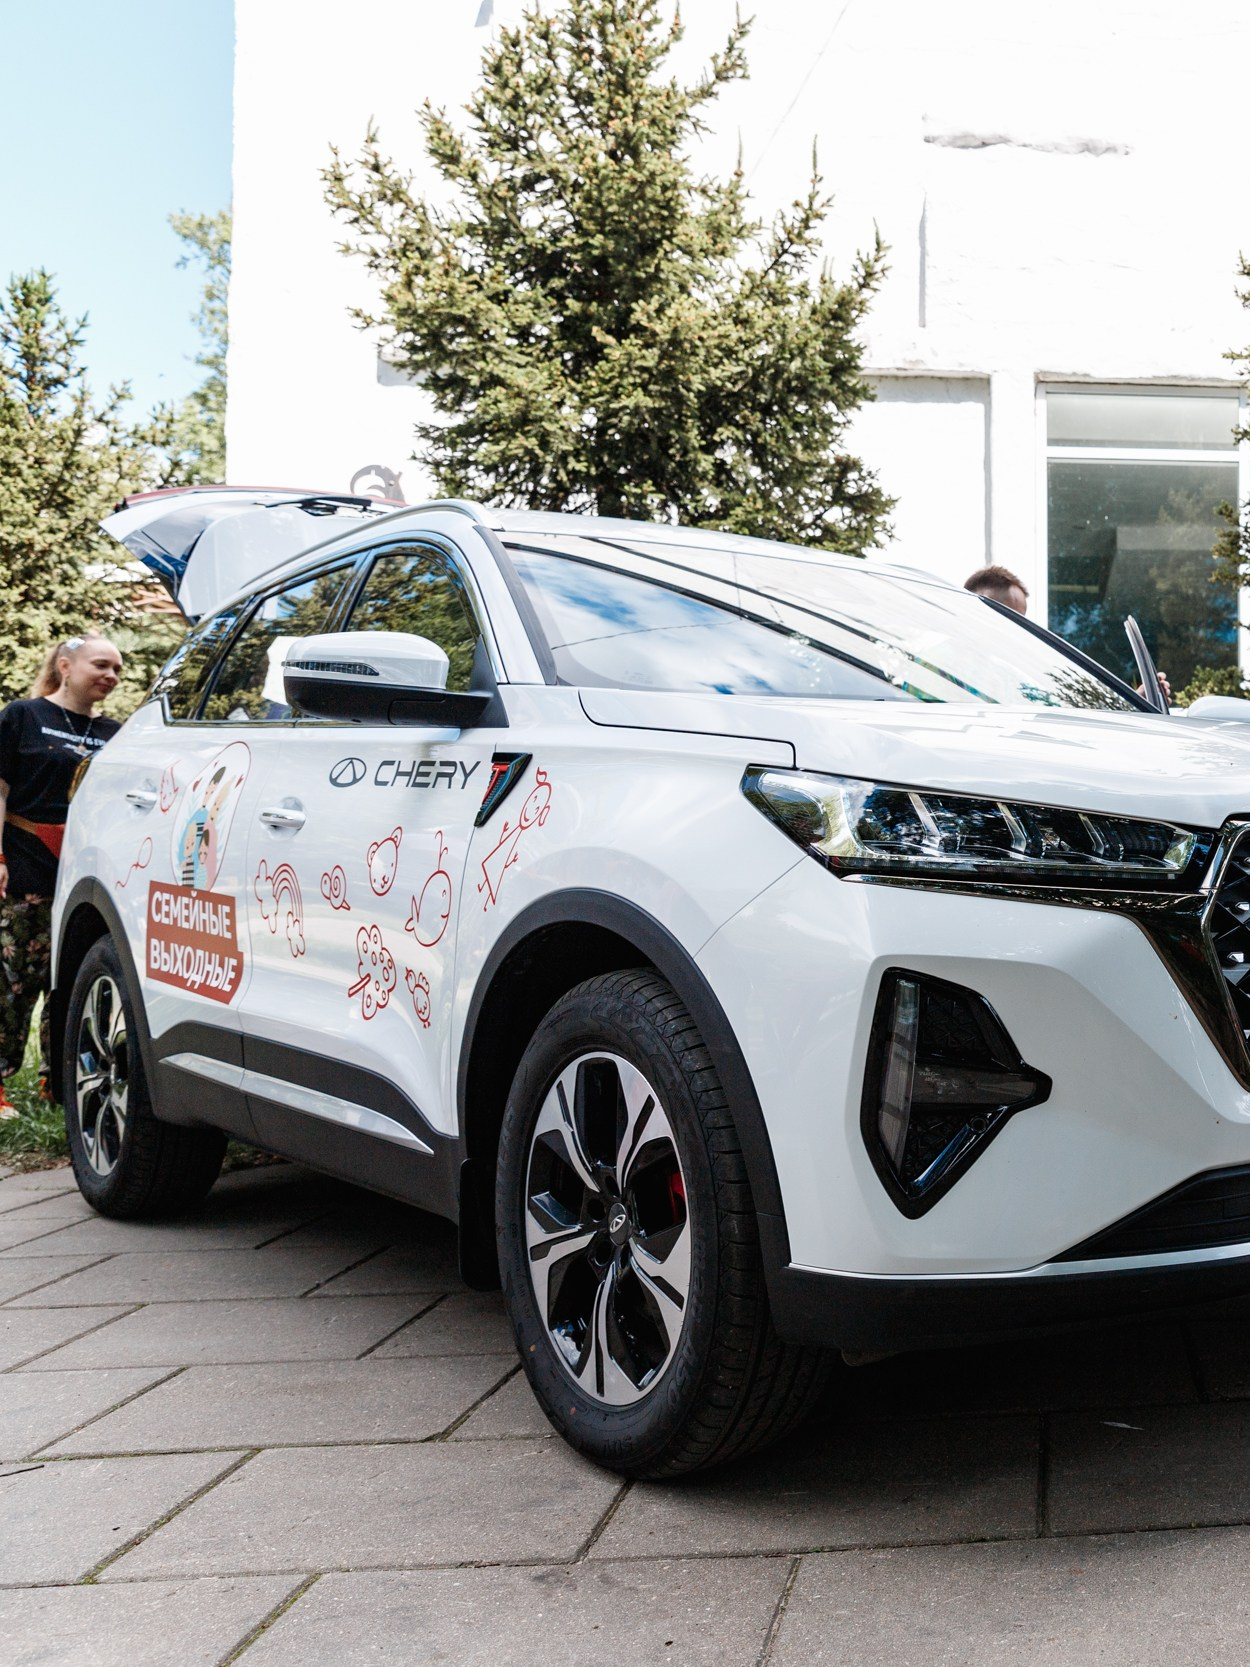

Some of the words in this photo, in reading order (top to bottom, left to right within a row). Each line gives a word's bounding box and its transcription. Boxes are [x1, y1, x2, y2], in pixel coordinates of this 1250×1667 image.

[374, 760, 481, 789] CHERY
[151, 890, 232, 939] СЕМЕЙНЫЕ
[150, 938, 238, 992] ВЫХОДНЫЕ
